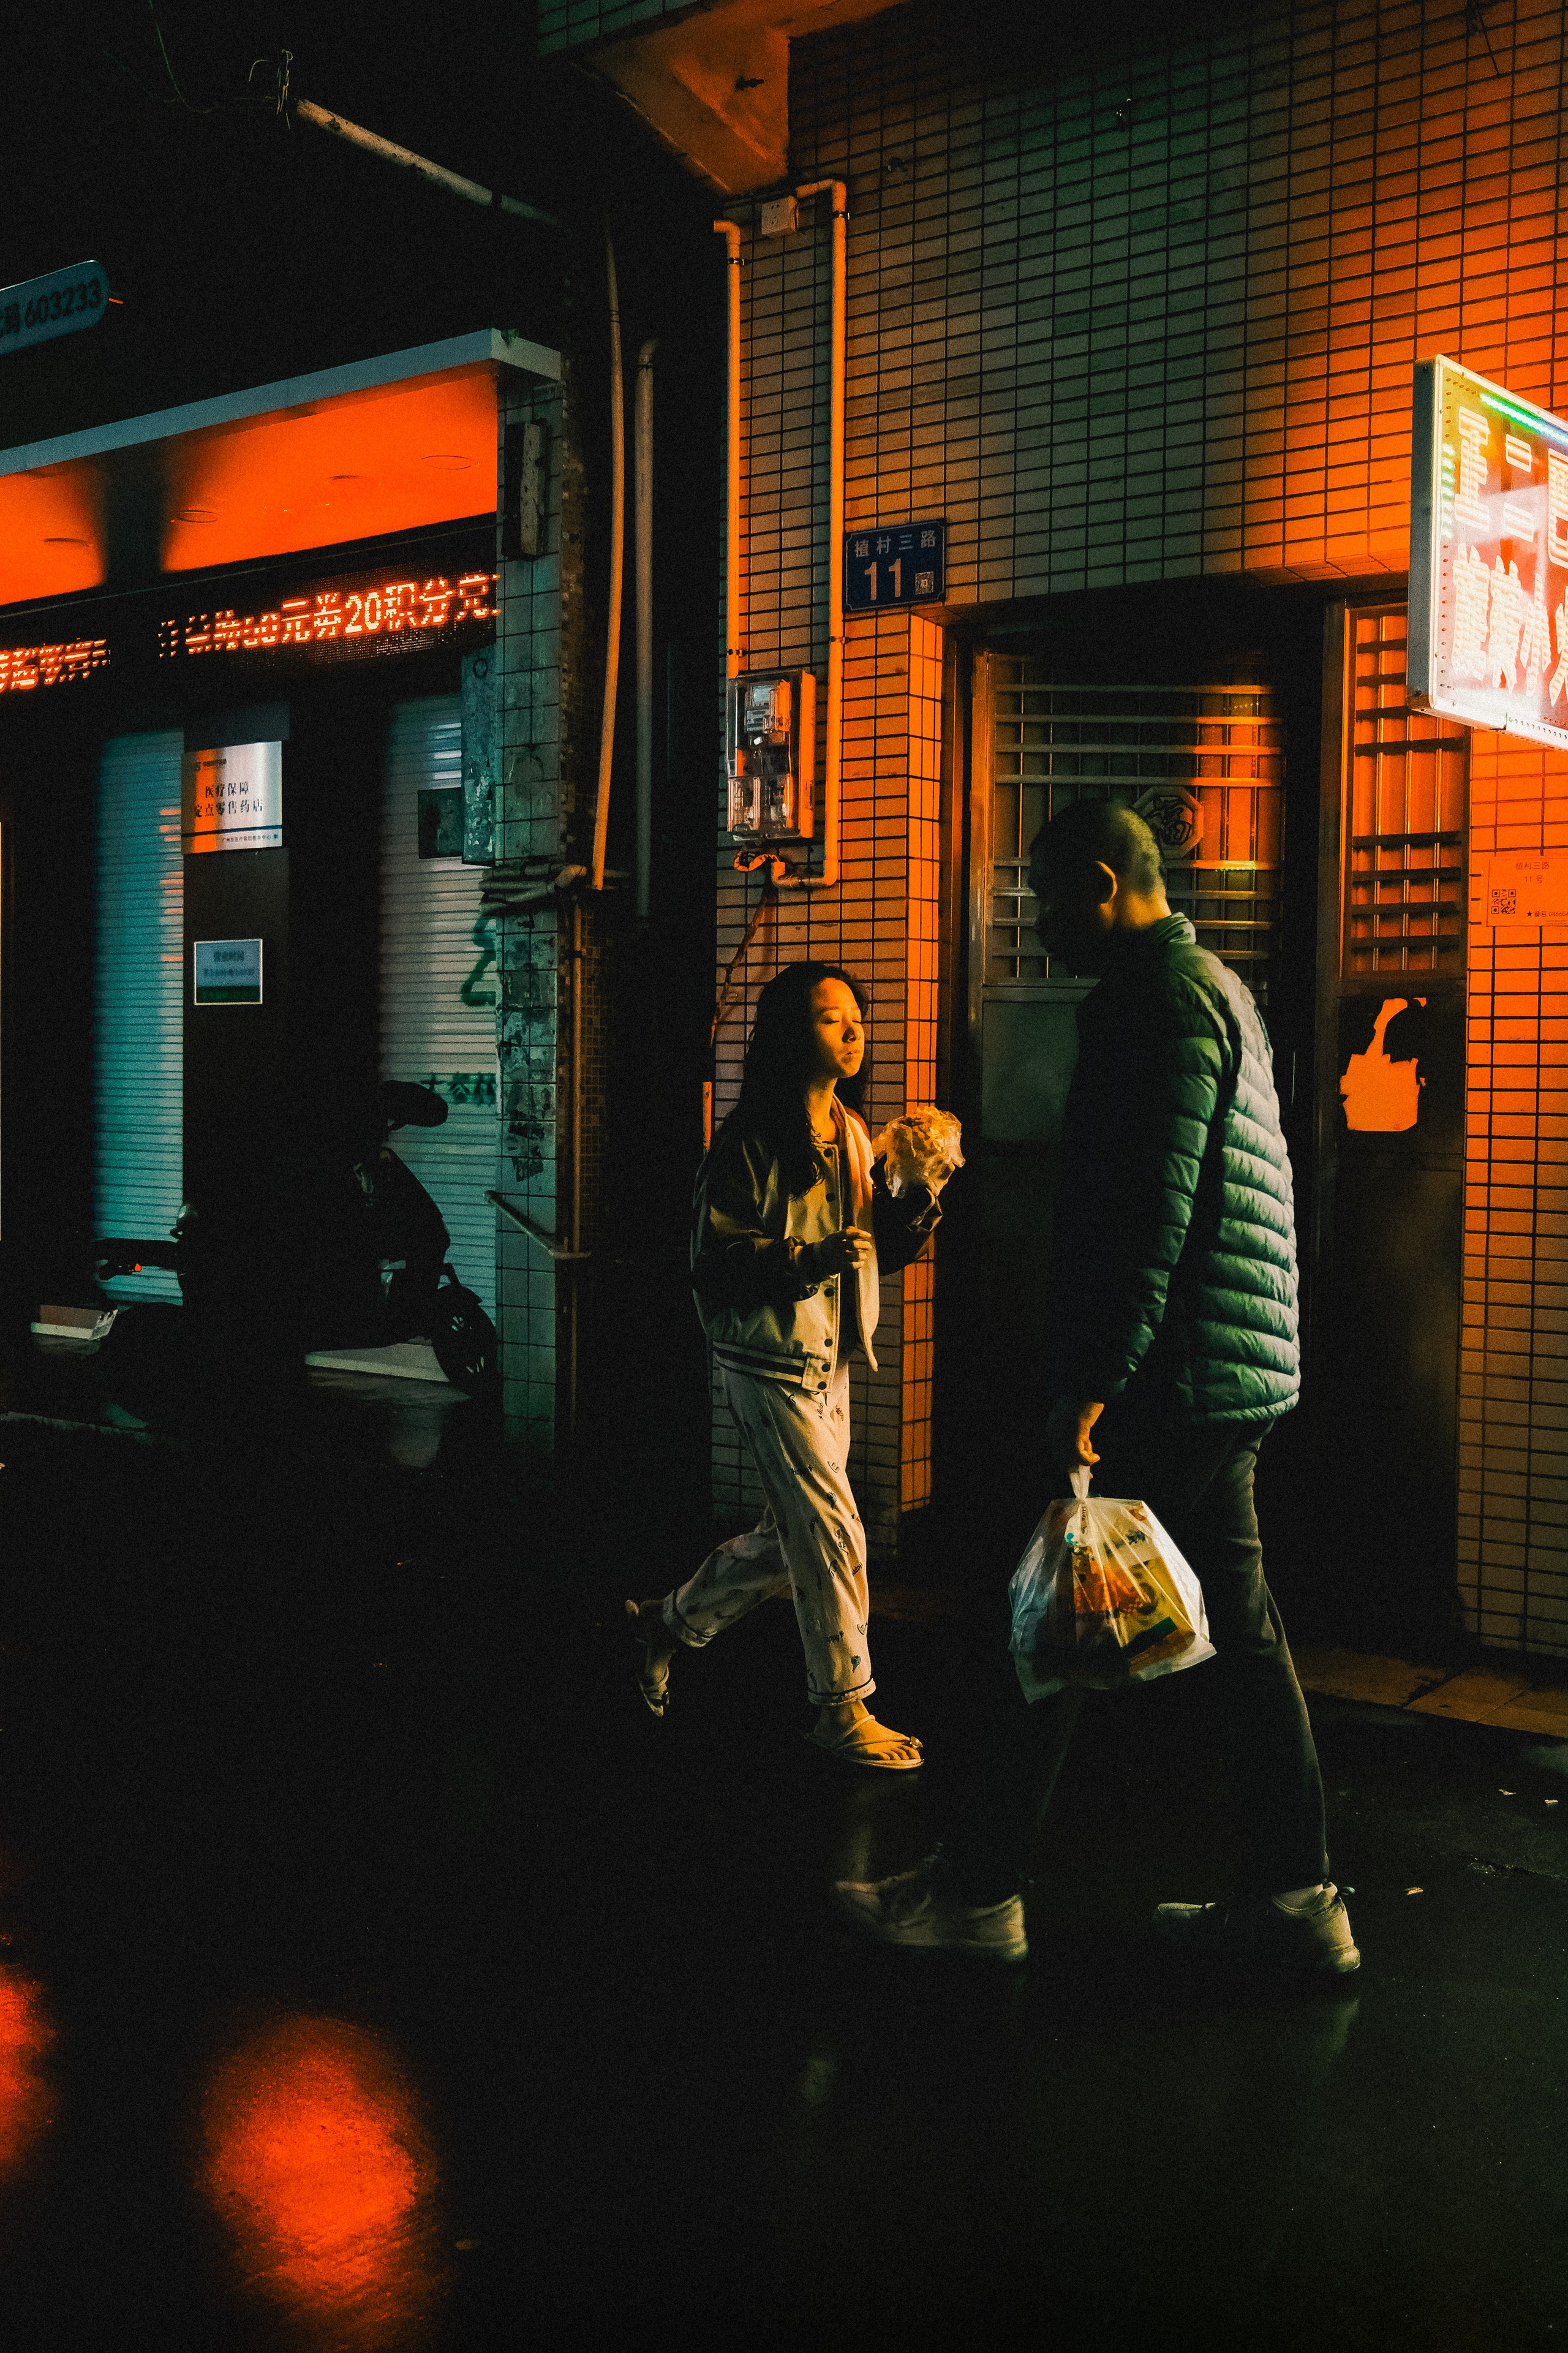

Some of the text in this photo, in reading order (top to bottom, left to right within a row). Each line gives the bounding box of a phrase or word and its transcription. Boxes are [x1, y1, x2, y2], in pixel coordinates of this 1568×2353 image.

[24, 278, 100, 327] 603233
[854, 529, 937, 558] 植村三路
[864, 557, 901, 601] 11
[205, 780, 249, 798] 医疗保障
[195, 798, 263, 818] 定点零售药店
[1515, 861, 1550, 870] 植村三路
